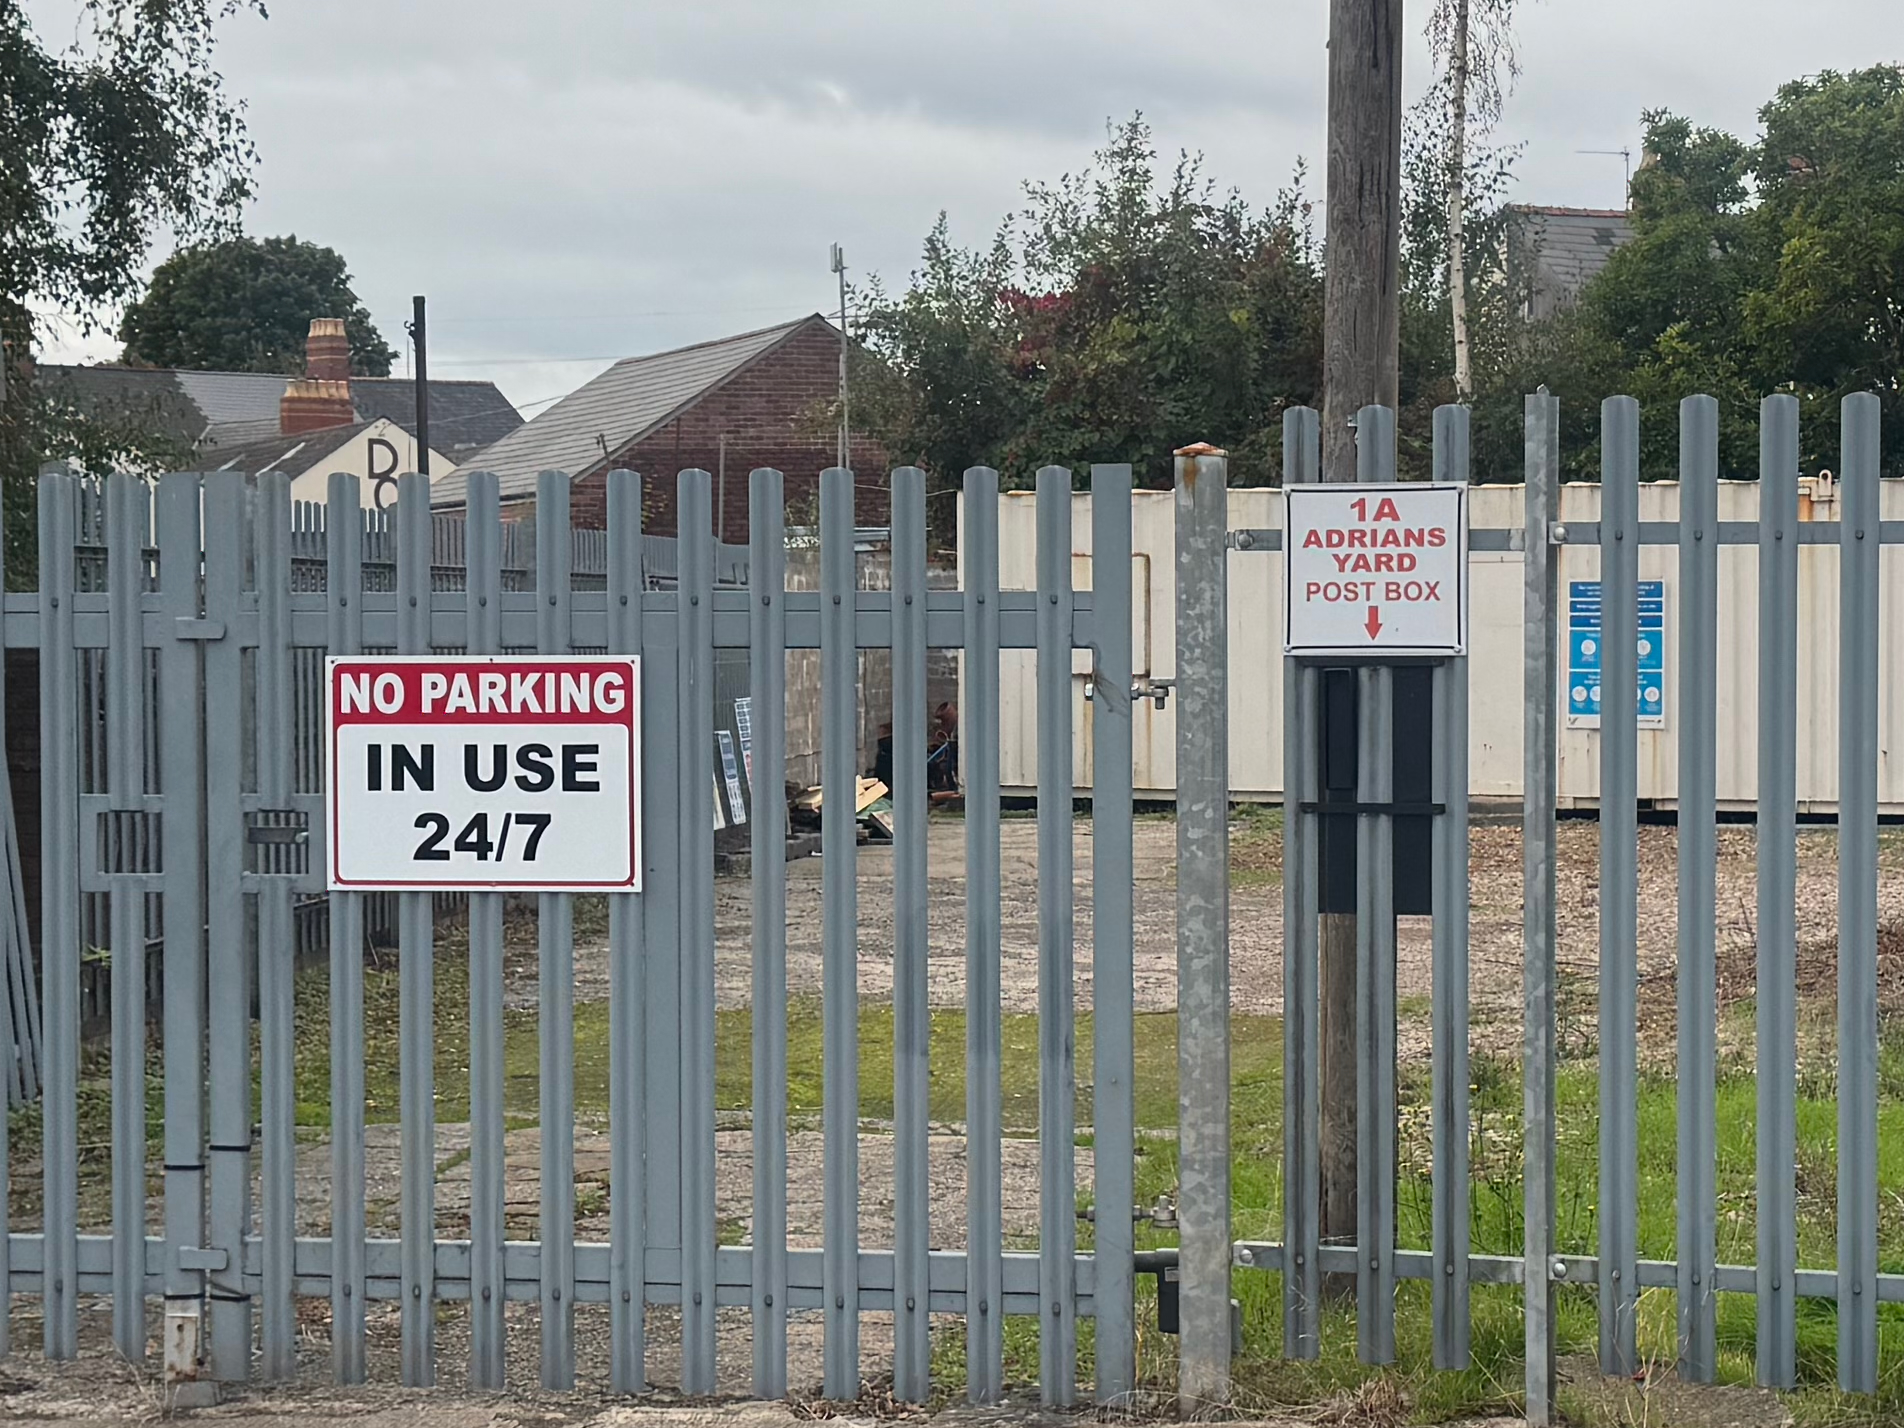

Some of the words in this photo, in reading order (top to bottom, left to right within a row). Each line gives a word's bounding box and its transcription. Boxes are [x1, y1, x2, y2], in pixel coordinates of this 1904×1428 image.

[1350, 498, 1401, 522] 1A
[1302, 528, 1447, 548] ADRIANS
[1332, 553, 1417, 573] YARD
[1306, 581, 1376, 602] POST
[1385, 580, 1441, 602] BOX
[340, 672, 405, 714] NO
[421, 672, 626, 714] PARKING
[367, 744, 435, 792] IN
[464, 743, 601, 793] USE
[412, 812, 552, 862] 24/7
